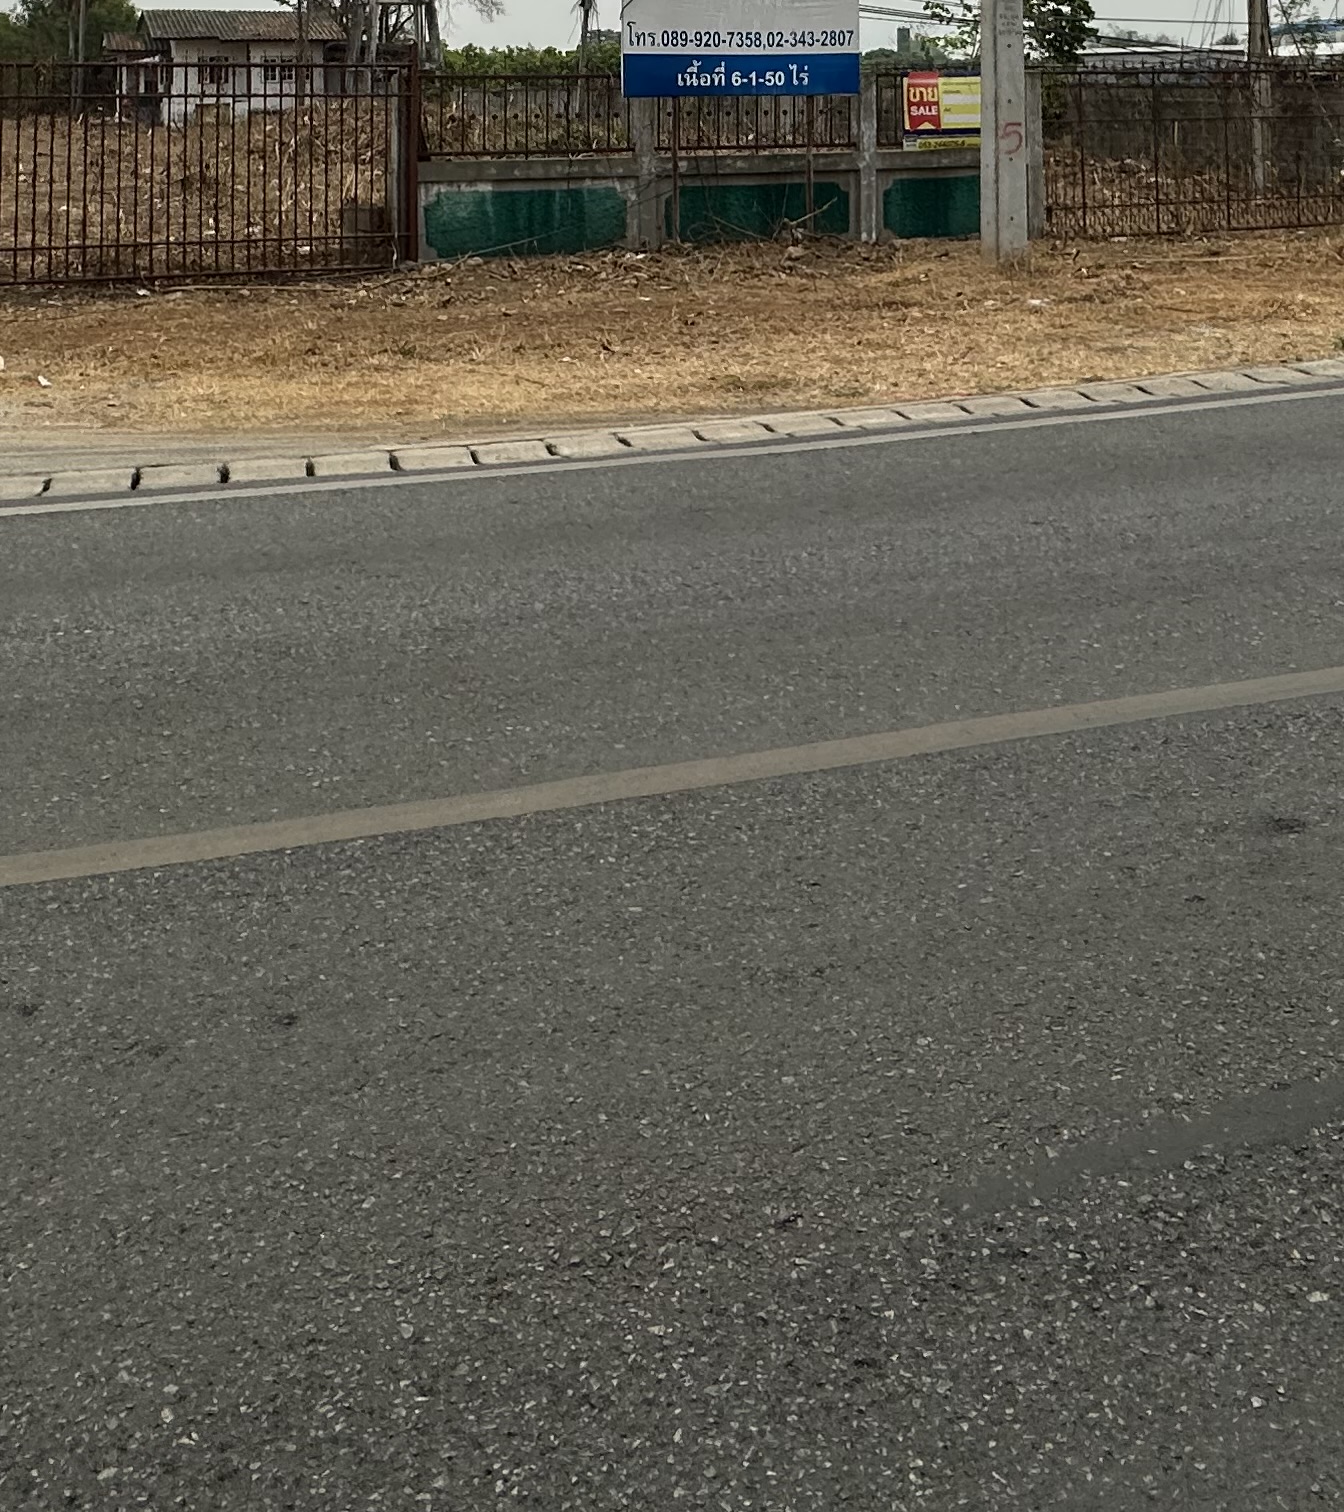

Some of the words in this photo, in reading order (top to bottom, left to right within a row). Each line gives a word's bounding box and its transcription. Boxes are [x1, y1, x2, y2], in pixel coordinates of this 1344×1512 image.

[677, 60, 726, 87] เนื้อที่
[731, 71, 785, 87] 6-1-50
[788, 64, 810, 86] ไร่
[908, 86, 939, 102] ขาย
[910, 105, 939, 116] SALE
